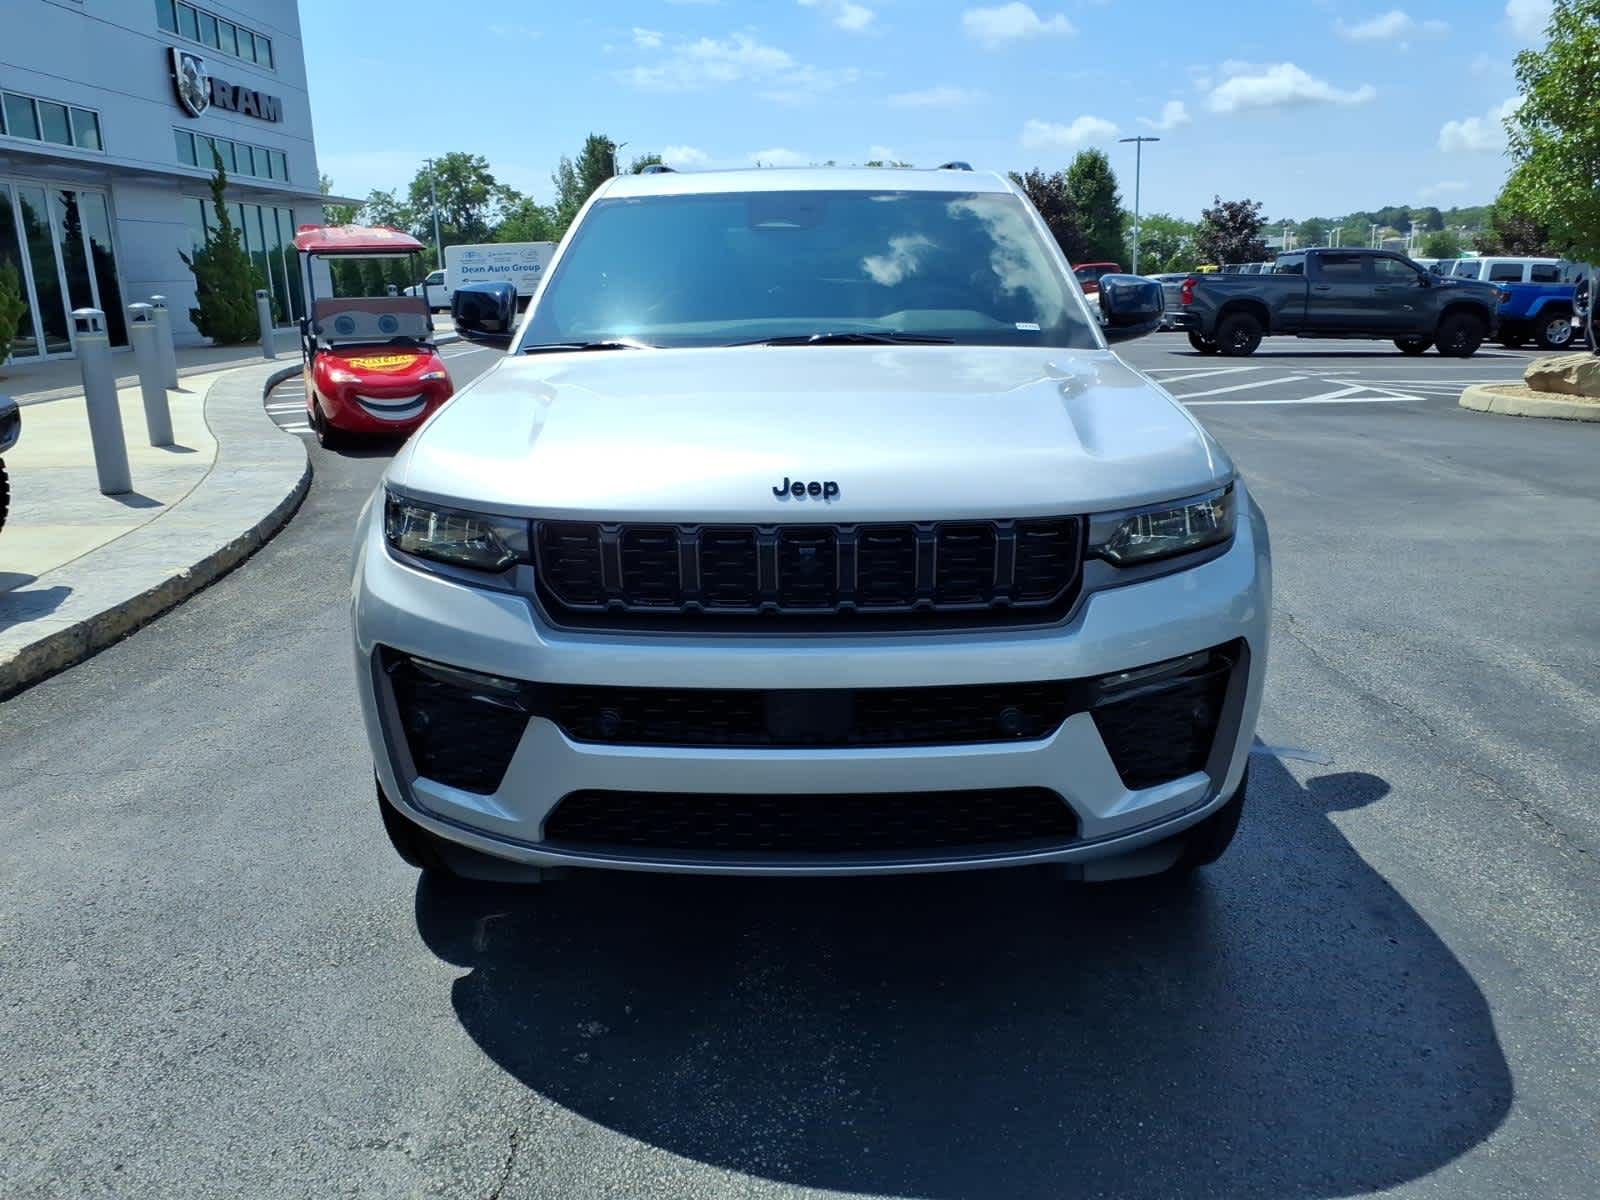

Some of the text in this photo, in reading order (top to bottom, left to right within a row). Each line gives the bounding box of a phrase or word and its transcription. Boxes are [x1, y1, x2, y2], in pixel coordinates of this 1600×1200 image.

[207, 76, 283, 123] RAM
[462, 263, 541, 274] Dean Auto Group
[772, 476, 840, 500] Jeep
